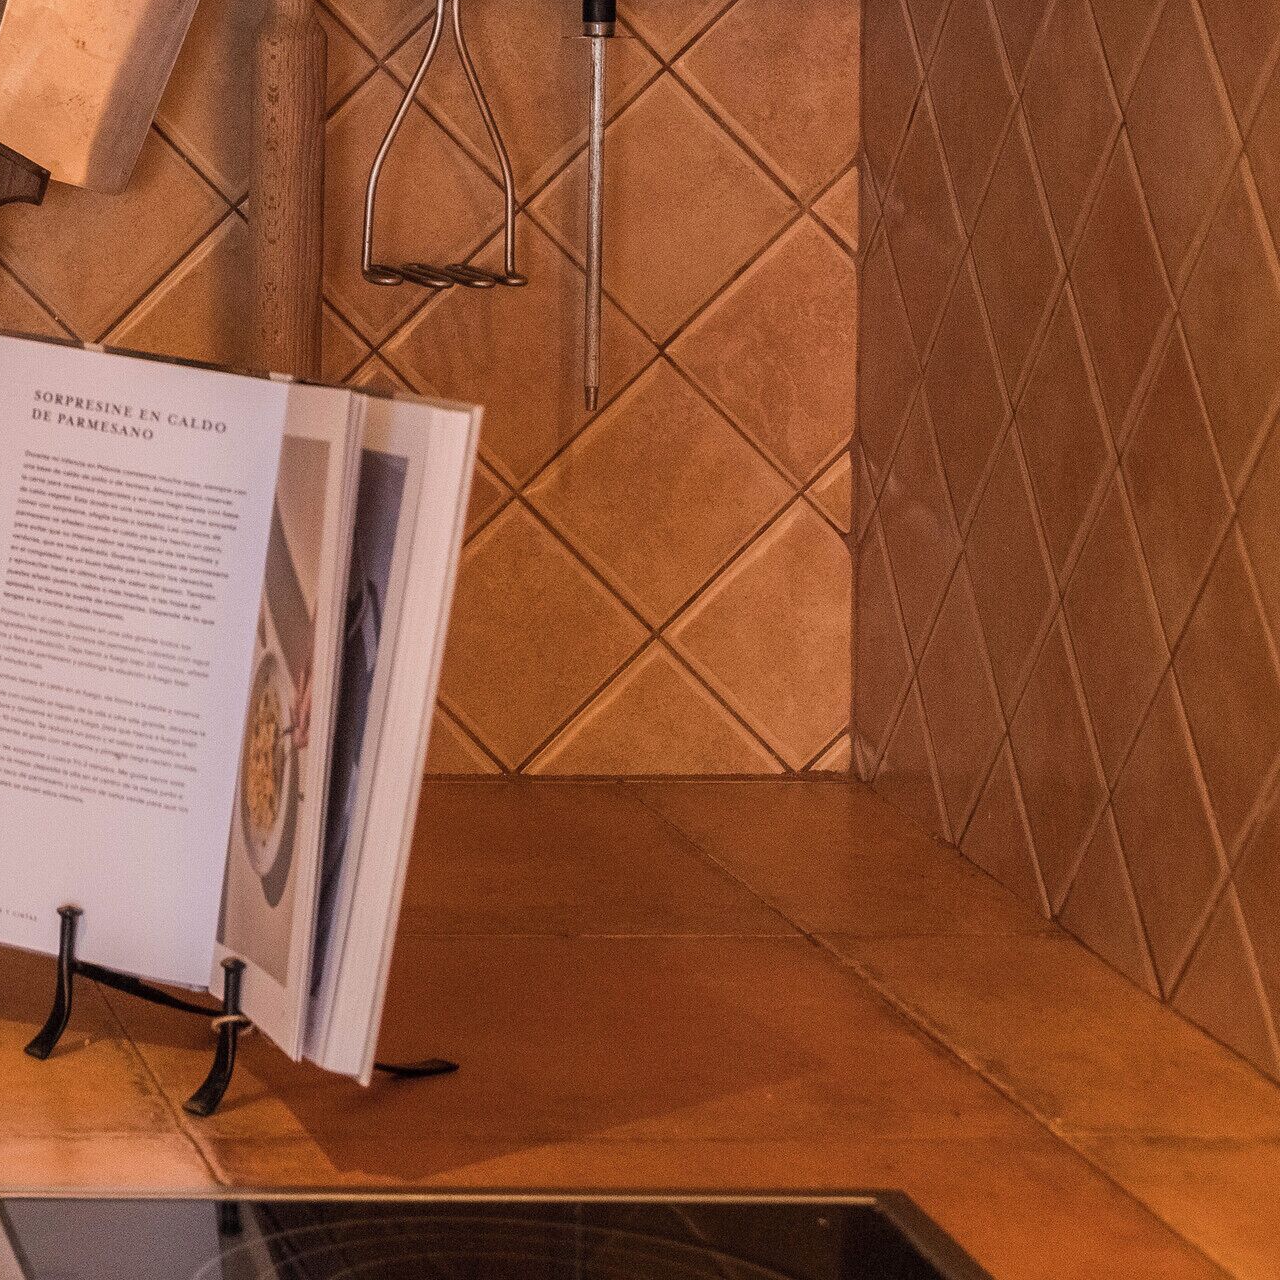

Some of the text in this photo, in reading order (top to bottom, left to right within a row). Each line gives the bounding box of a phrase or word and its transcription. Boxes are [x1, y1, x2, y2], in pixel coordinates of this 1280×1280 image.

[31, 407, 155, 441] DE PARMESANO
[33, 390, 228, 435] SORPRESINE EN CALDO
